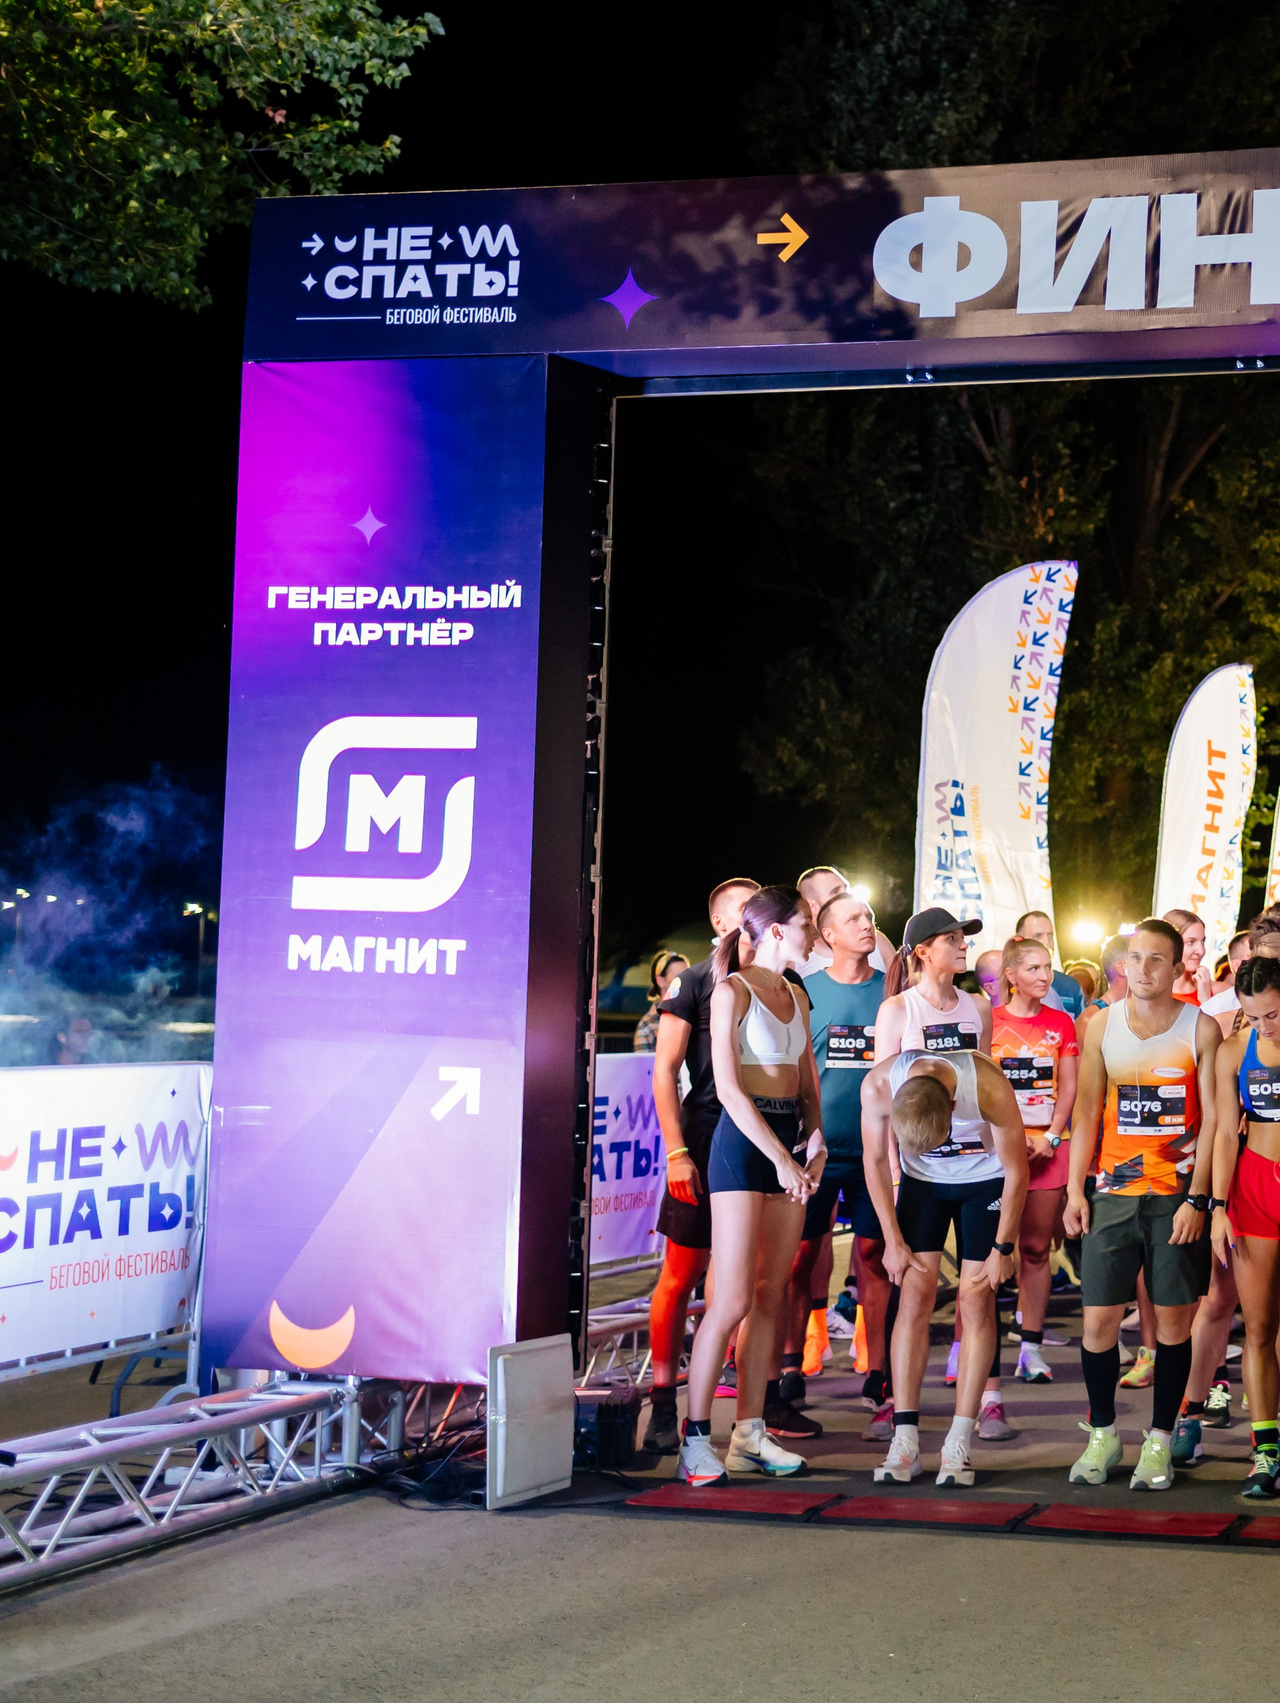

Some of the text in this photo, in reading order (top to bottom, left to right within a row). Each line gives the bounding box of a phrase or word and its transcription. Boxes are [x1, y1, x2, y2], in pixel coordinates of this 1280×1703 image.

[362, 226, 433, 261] НЕ
[324, 260, 520, 300] СПАТЬ!
[386, 305, 517, 325] БЕГОВОЙ ФЕСТИВАЛЬ
[267, 579, 523, 610] ГЕНЕРАЛЬНЫЙ
[313, 617, 475, 646] ПАРТНЁР
[287, 934, 467, 976] МАГНИТ
[829, 1037, 866, 1049] 5108
[926, 1036, 960, 1049] 5181
[1003, 1069, 1038, 1079] 5254
[1120, 1100, 1162, 1113] 5076
[26, 1124, 106, 1184] НЕ
[592, 1135, 661, 1182] АТЬ!
[50, 1247, 191, 1291] БЕГОВОЙ ФЕСТИВАЛЬ
